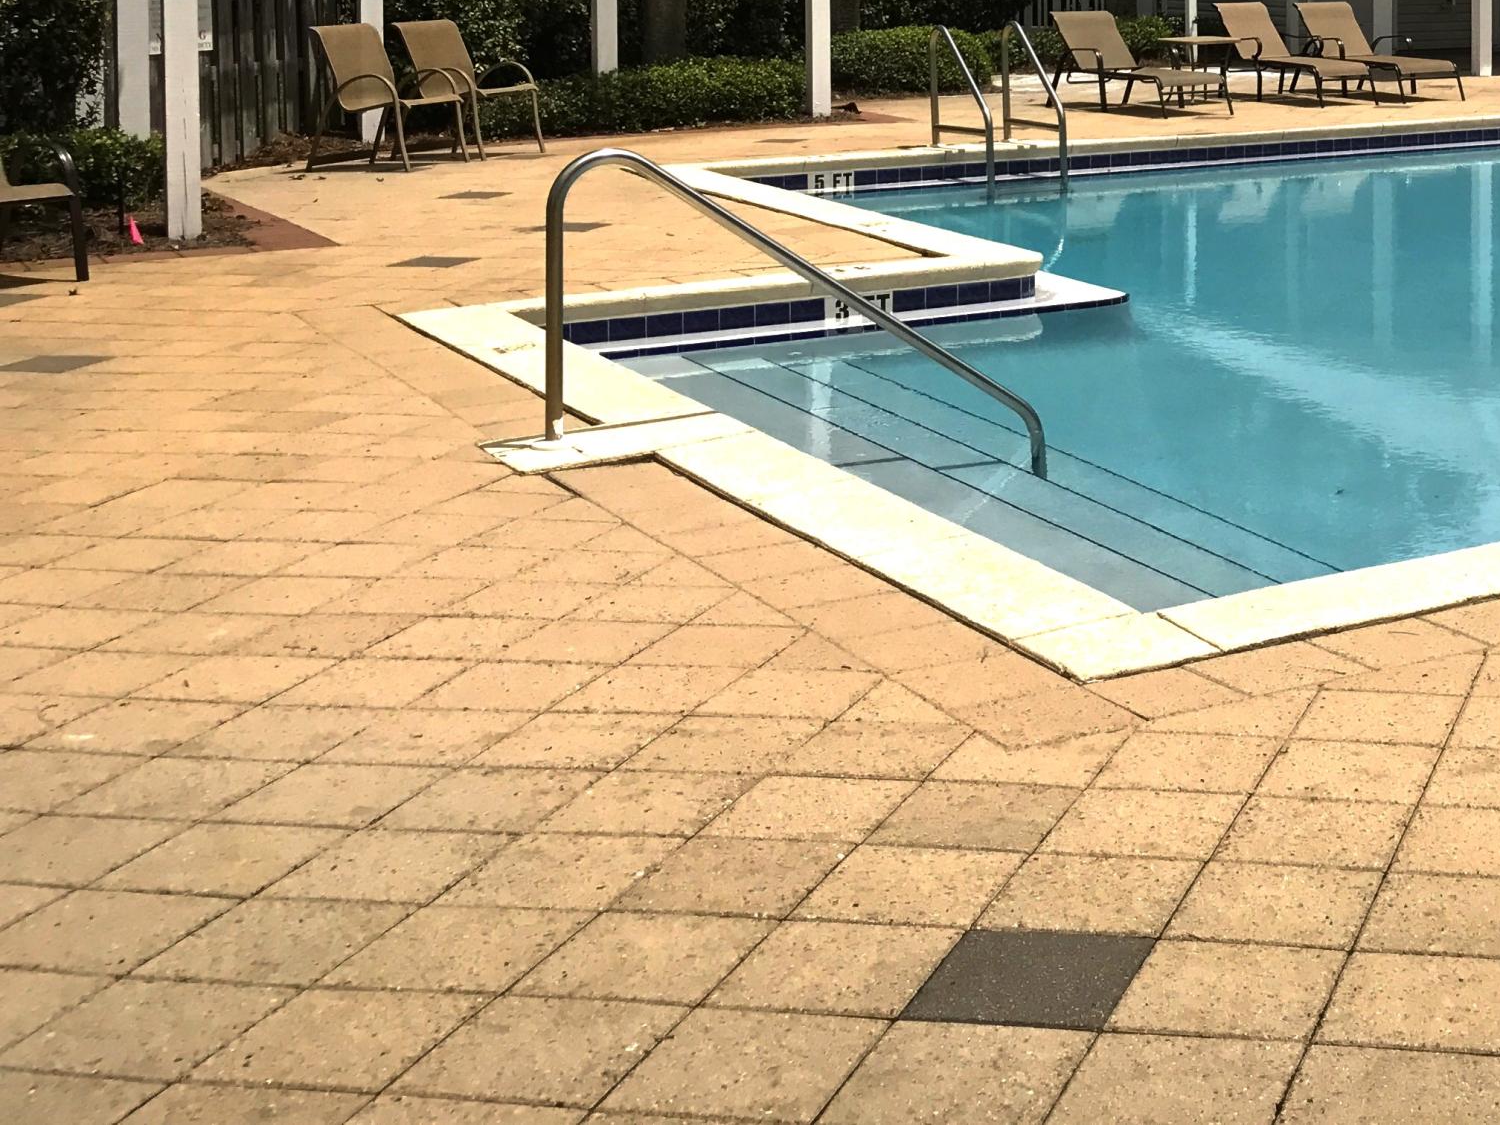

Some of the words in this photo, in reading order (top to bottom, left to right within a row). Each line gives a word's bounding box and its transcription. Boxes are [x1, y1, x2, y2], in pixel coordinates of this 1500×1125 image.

[815, 174, 824, 189] 5
[832, 173, 852, 188] FT
[835, 299, 850, 319] 3
